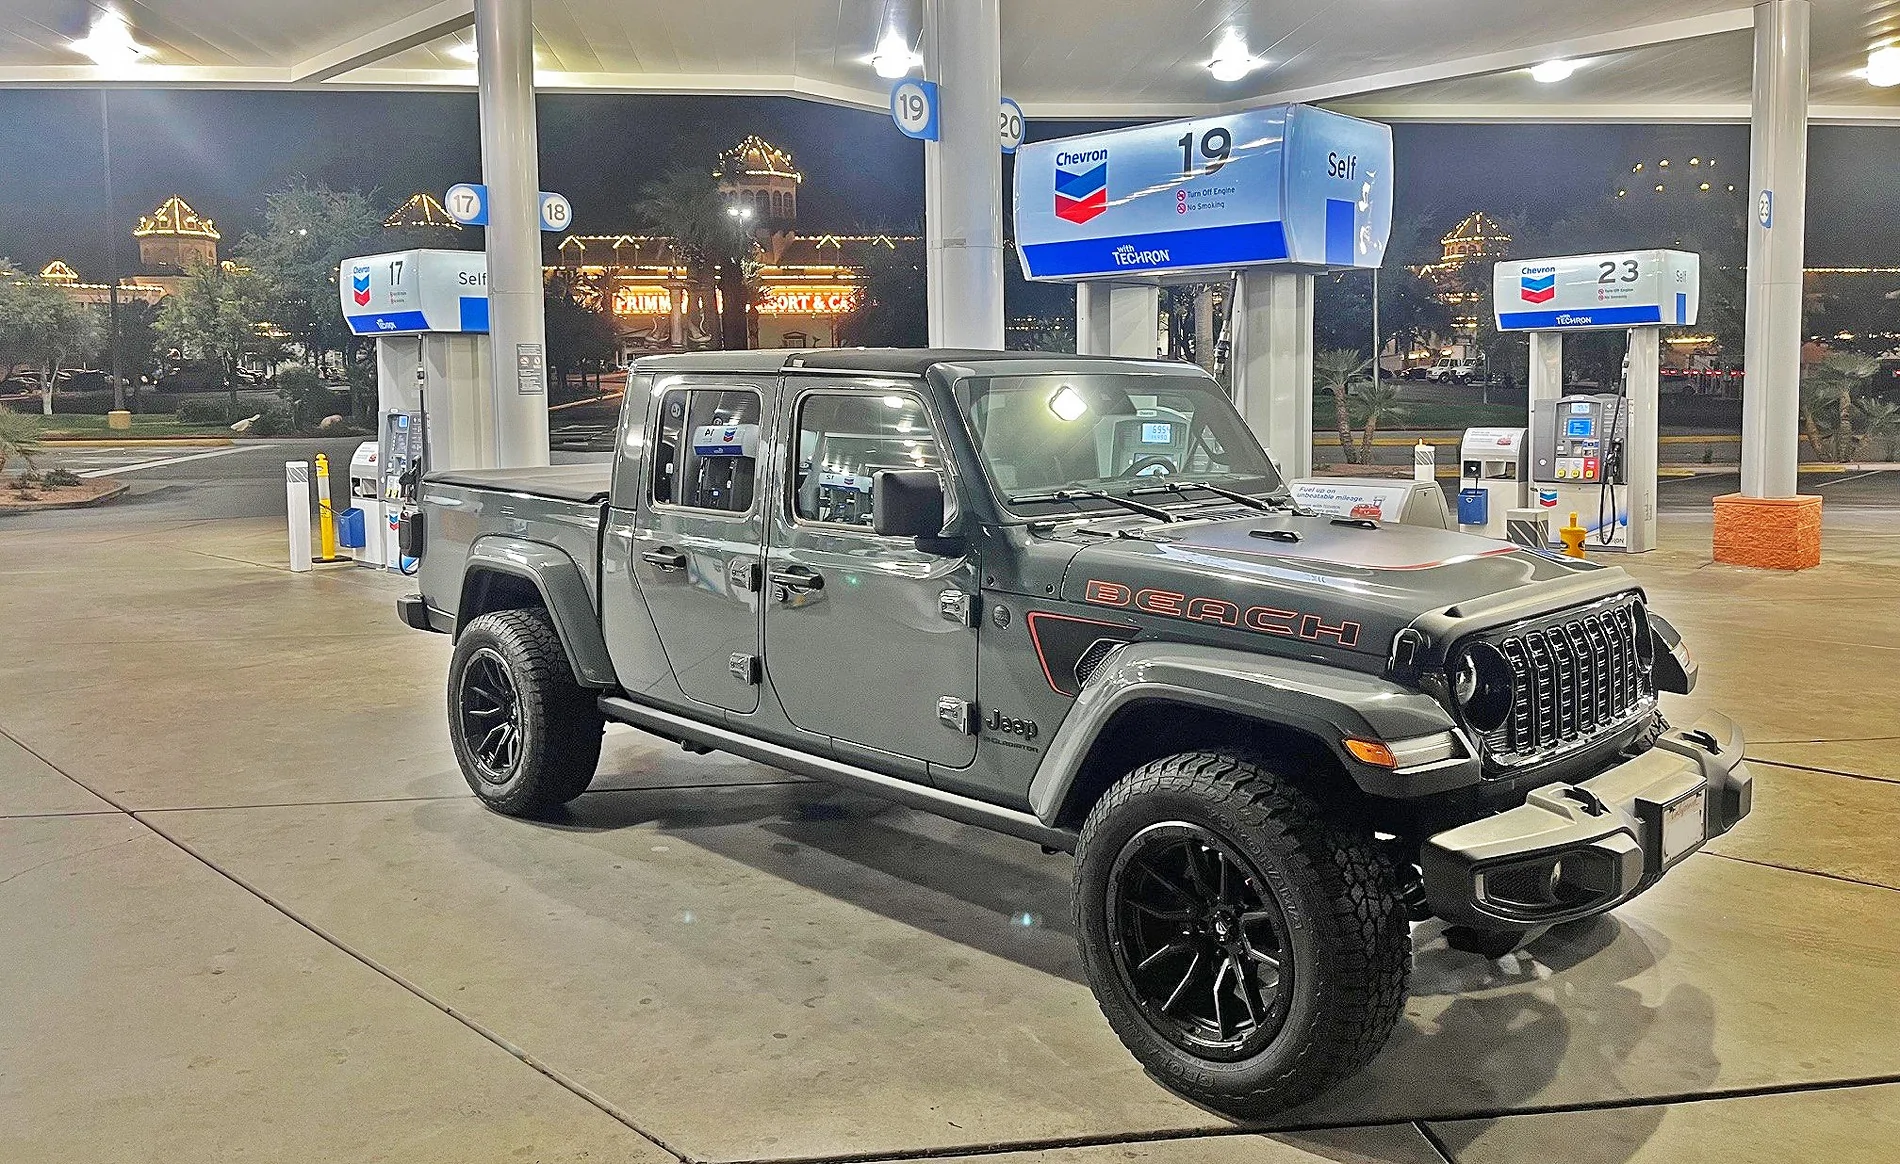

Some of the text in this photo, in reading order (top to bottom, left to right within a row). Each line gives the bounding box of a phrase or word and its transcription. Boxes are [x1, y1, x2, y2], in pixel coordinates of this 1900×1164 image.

[900, 94, 924, 121] 19
[1000, 113, 1021, 139] 20
[1056, 149, 1108, 167] Chevron
[1178, 127, 1232, 178] 19
[1327, 151, 1357, 180] Self
[1187, 186, 1236, 199] Turn Off Engine
[454, 194, 474, 213] 17
[546, 203, 566, 221] 18
[1187, 201, 1225, 211] No Smoking
[1760, 200, 1769, 217] 23
[1112, 249, 1171, 265] TECHRON
[1117, 244, 1135, 253] with
[389, 260, 404, 286] 17
[458, 271, 487, 286] Self
[1521, 266, 1556, 275] Chevron
[1598, 259, 1639, 284] 23
[767, 295, 810, 310] SORT
[812, 295, 826, 310] &
[1555, 316, 1592, 325] TECHRON
[1296, 492, 1365, 503] unbeatable mileage.
[1299, 486, 1315, 494] Fuel
[1084, 579, 1362, 648] BEACH
[984, 707, 1039, 741] Jeep
